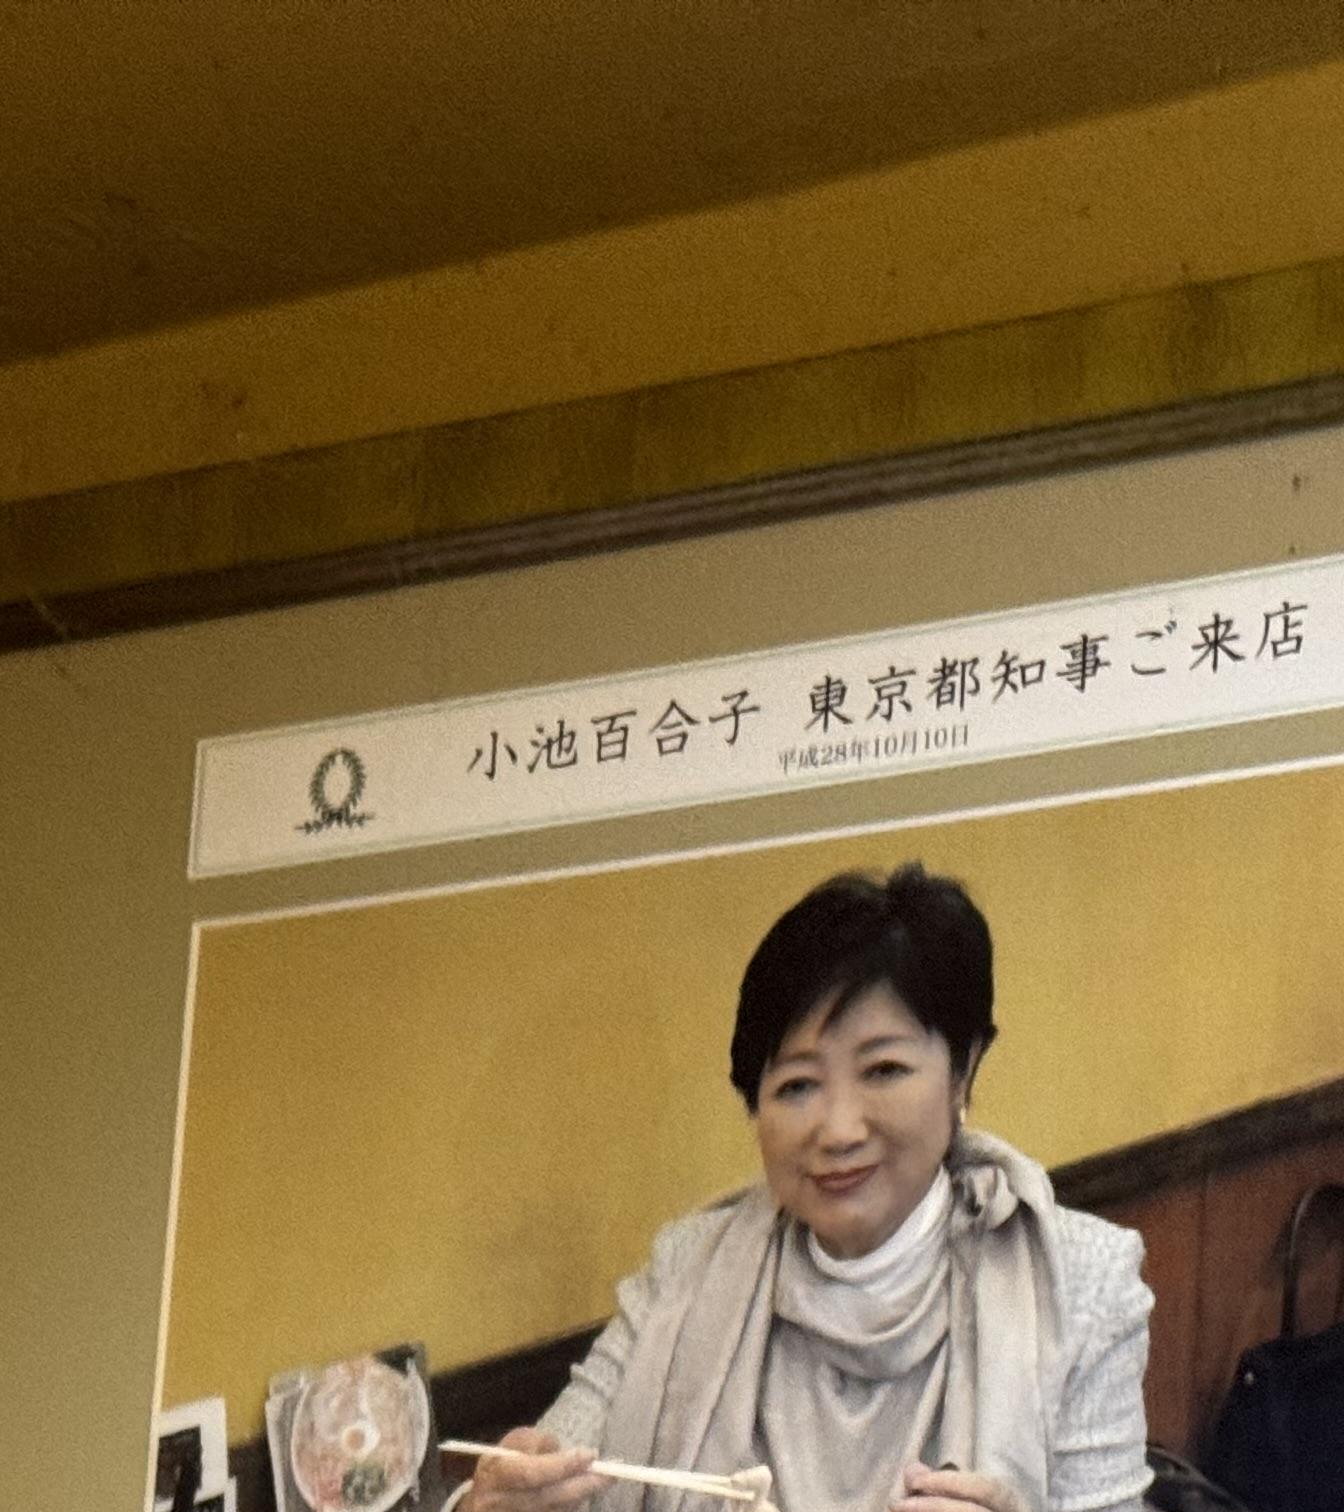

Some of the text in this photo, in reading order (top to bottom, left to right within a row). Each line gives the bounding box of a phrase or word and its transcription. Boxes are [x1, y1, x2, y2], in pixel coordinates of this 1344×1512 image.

[467, 601, 1309, 781] 小池百合子 東京都知事ご来店
[778, 724, 969, 776] 平成28年10月10日
